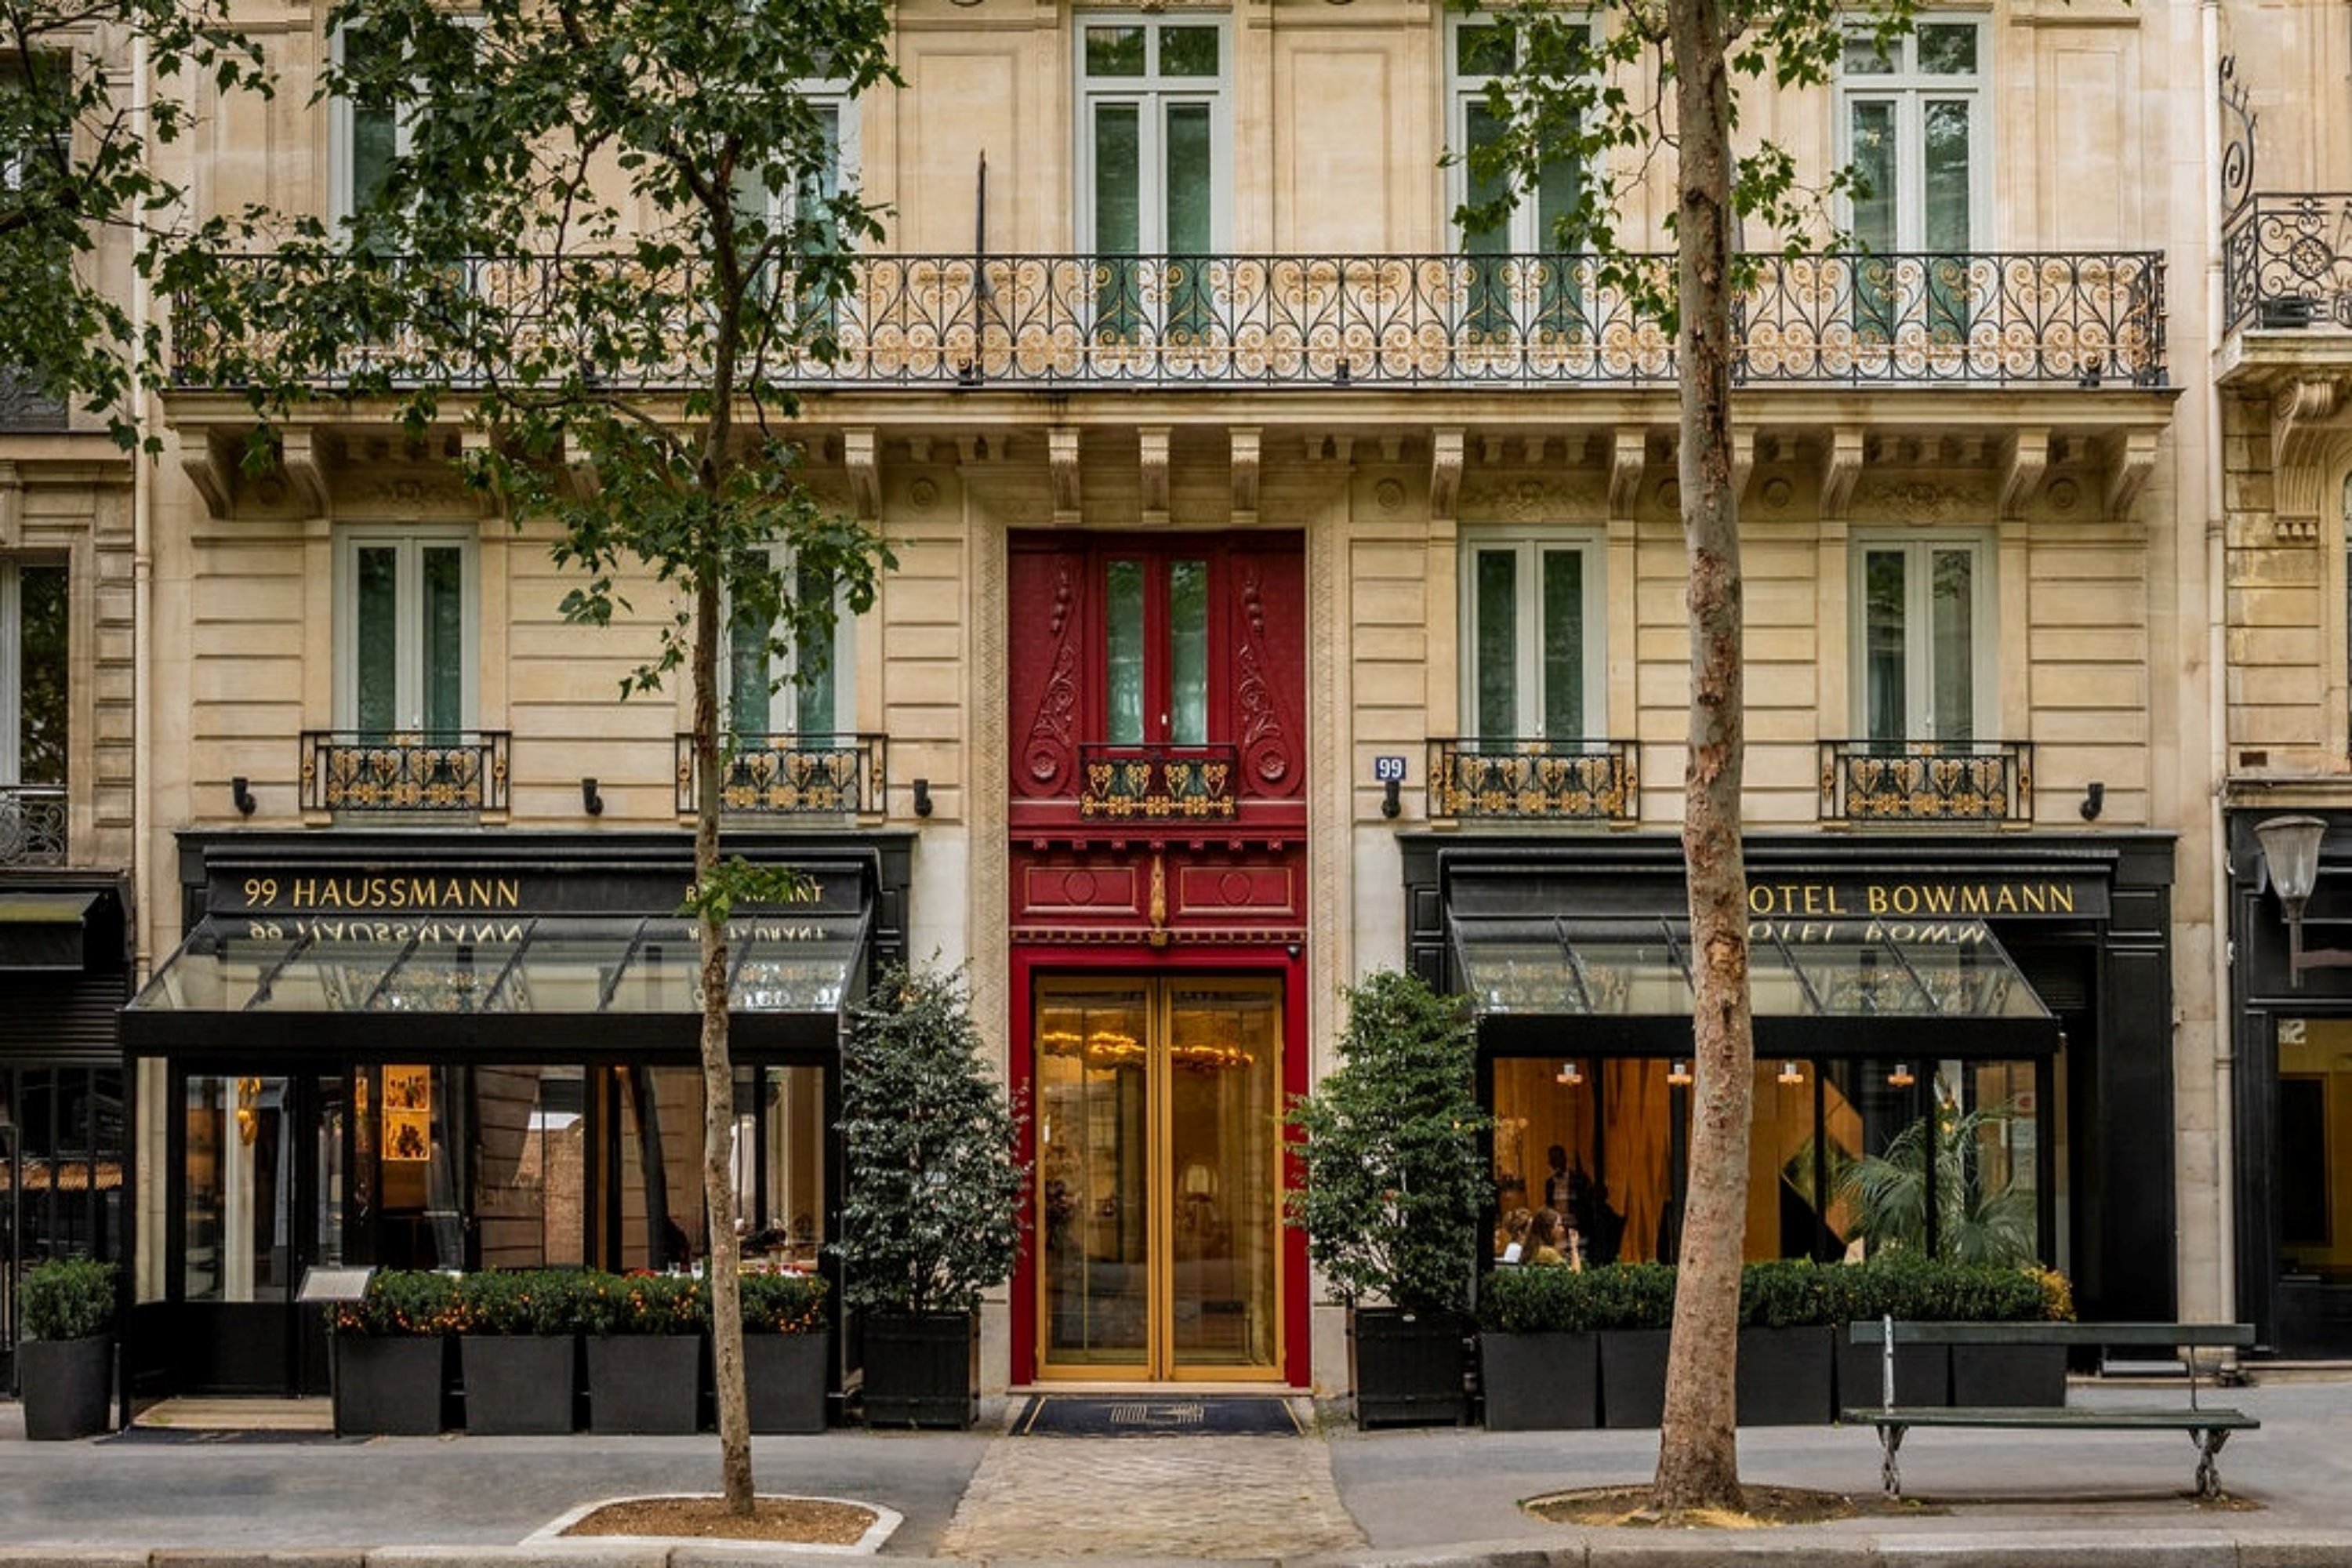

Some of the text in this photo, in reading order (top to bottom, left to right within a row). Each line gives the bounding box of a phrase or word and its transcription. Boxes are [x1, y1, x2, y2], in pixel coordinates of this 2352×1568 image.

[1380, 759, 1402, 778] 99
[244, 879, 520, 907] 99 HAUSSMANN
[1748, 884, 2073, 914] OTEL BOWMANN
